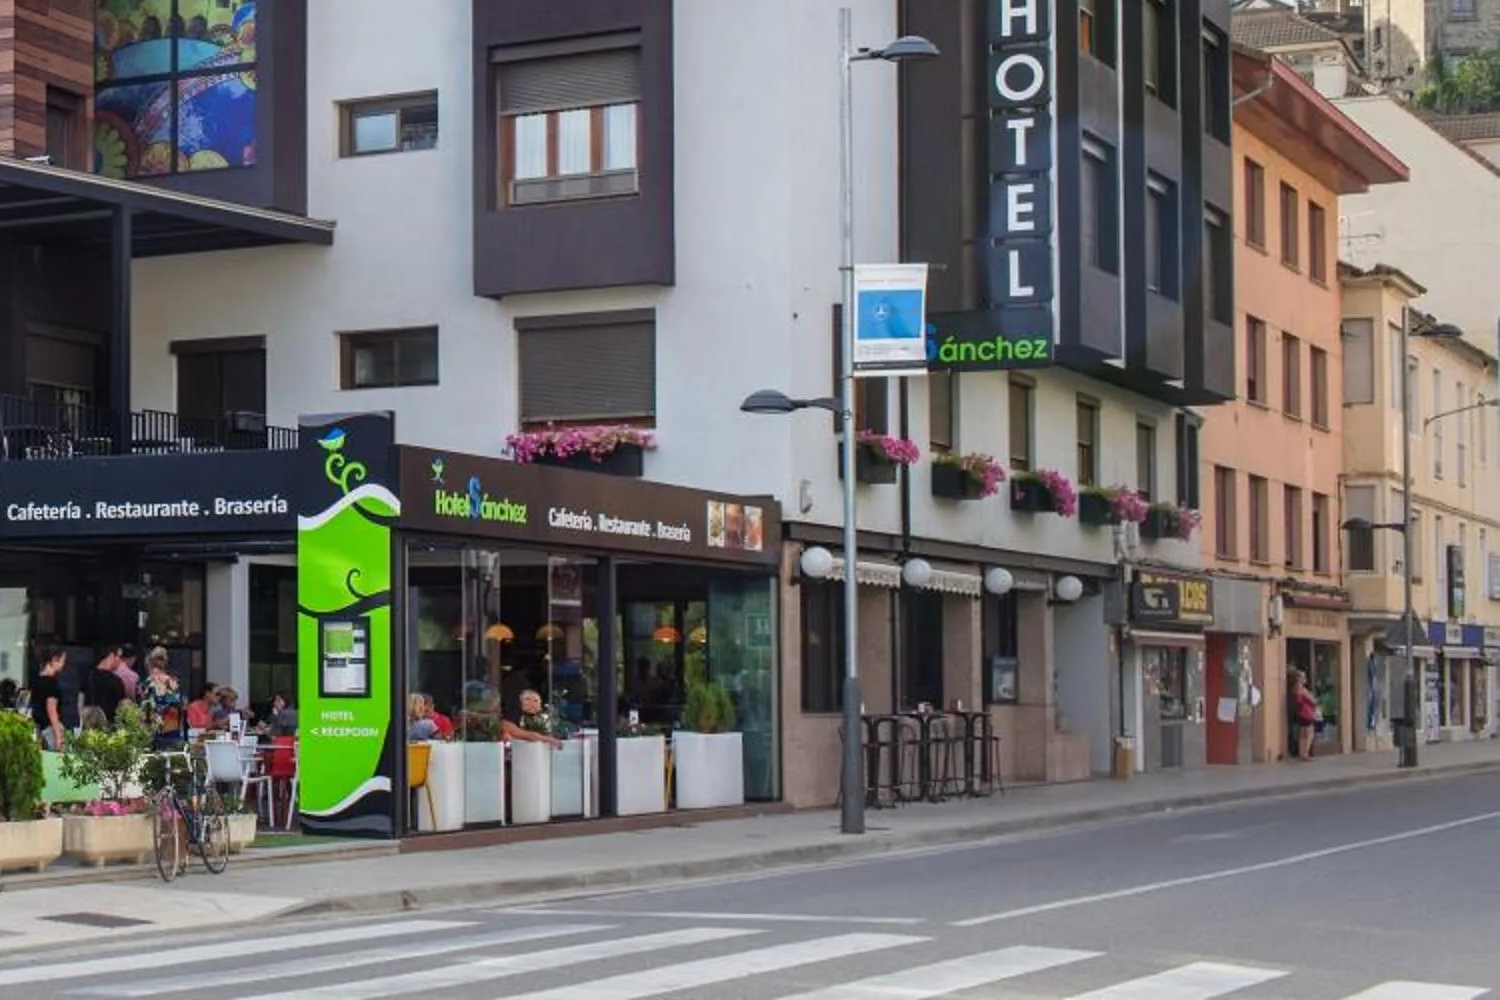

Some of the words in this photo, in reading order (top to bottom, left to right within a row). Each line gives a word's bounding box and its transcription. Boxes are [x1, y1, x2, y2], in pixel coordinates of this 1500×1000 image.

[7, 501, 81, 521] Cafetería
[96, 501, 200, 520] Restaurante
[214, 494, 288, 516] Brasería
[436, 489, 469, 517] Hotel
[548, 507, 593, 531] Cafetería
[598, 513, 652, 537] Restaurante
[321, 711, 355, 721] HOTEL
